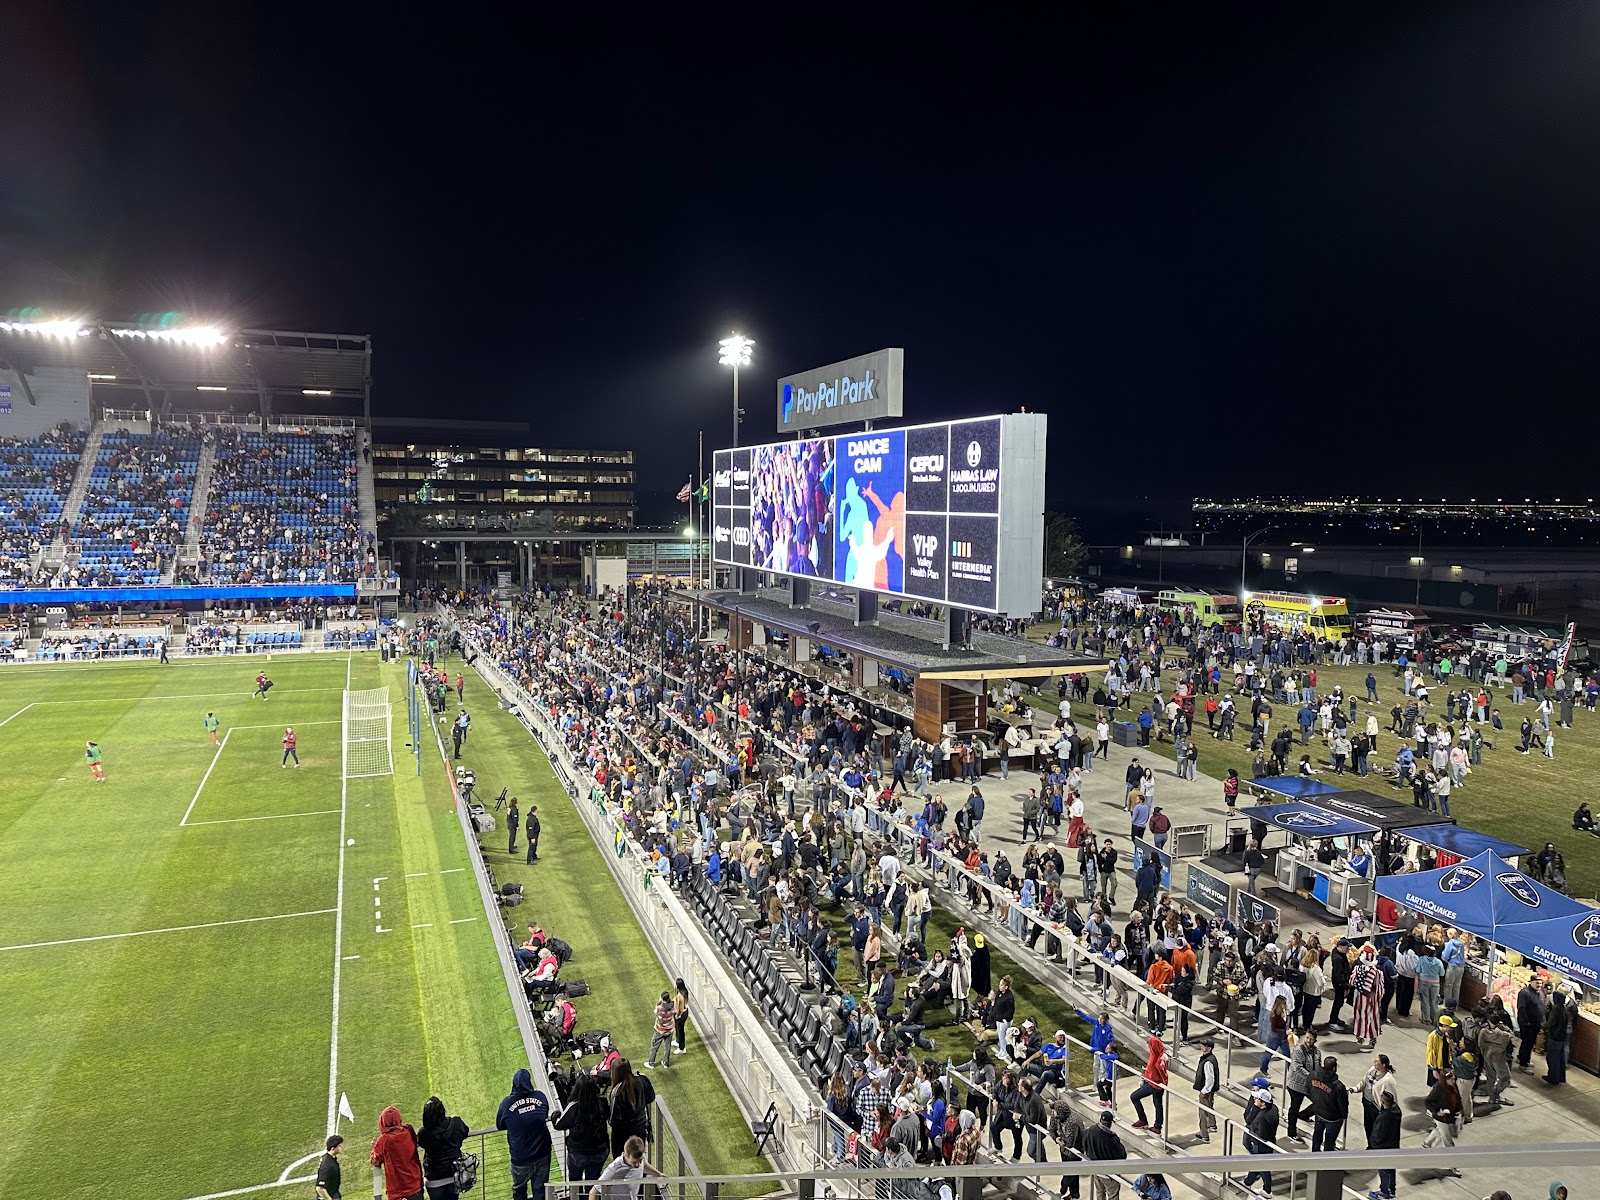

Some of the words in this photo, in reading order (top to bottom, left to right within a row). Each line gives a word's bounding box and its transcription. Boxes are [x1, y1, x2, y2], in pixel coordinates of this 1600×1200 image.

[796, 379, 839, 415] PayPal
[841, 370, 874, 405] Park
[847, 438, 890, 456] DANCE
[854, 457, 882, 473] CAM
[909, 455, 944, 473] CEFCU
[950, 470, 979, 482] HABBAS
[980, 469, 998, 481] LAW
[912, 533, 938, 557] VHP
[917, 557, 932, 569] Valley
[910, 567, 927, 578] Health
[927, 569, 939, 580] Plan
[1372, 618, 1391, 626] KOREAN
[1392, 620, 1402, 628] BBQ
[1455, 867, 1480, 879] QUAKES
[1198, 883, 1211, 893] TEAM
[1211, 890, 1227, 902] STORE
[1405, 893, 1457, 920] EARTHQUAKES
[1533, 945, 1598, 980] EARTHQUAKES
[1544, 958, 1555, 967] SAN
[1556, 963, 1569, 973] JOSE
[509, 1098, 525, 1112] UNITED
[526, 1097, 543, 1107] STATES
[518, 1104, 536, 1115] SOCCER
